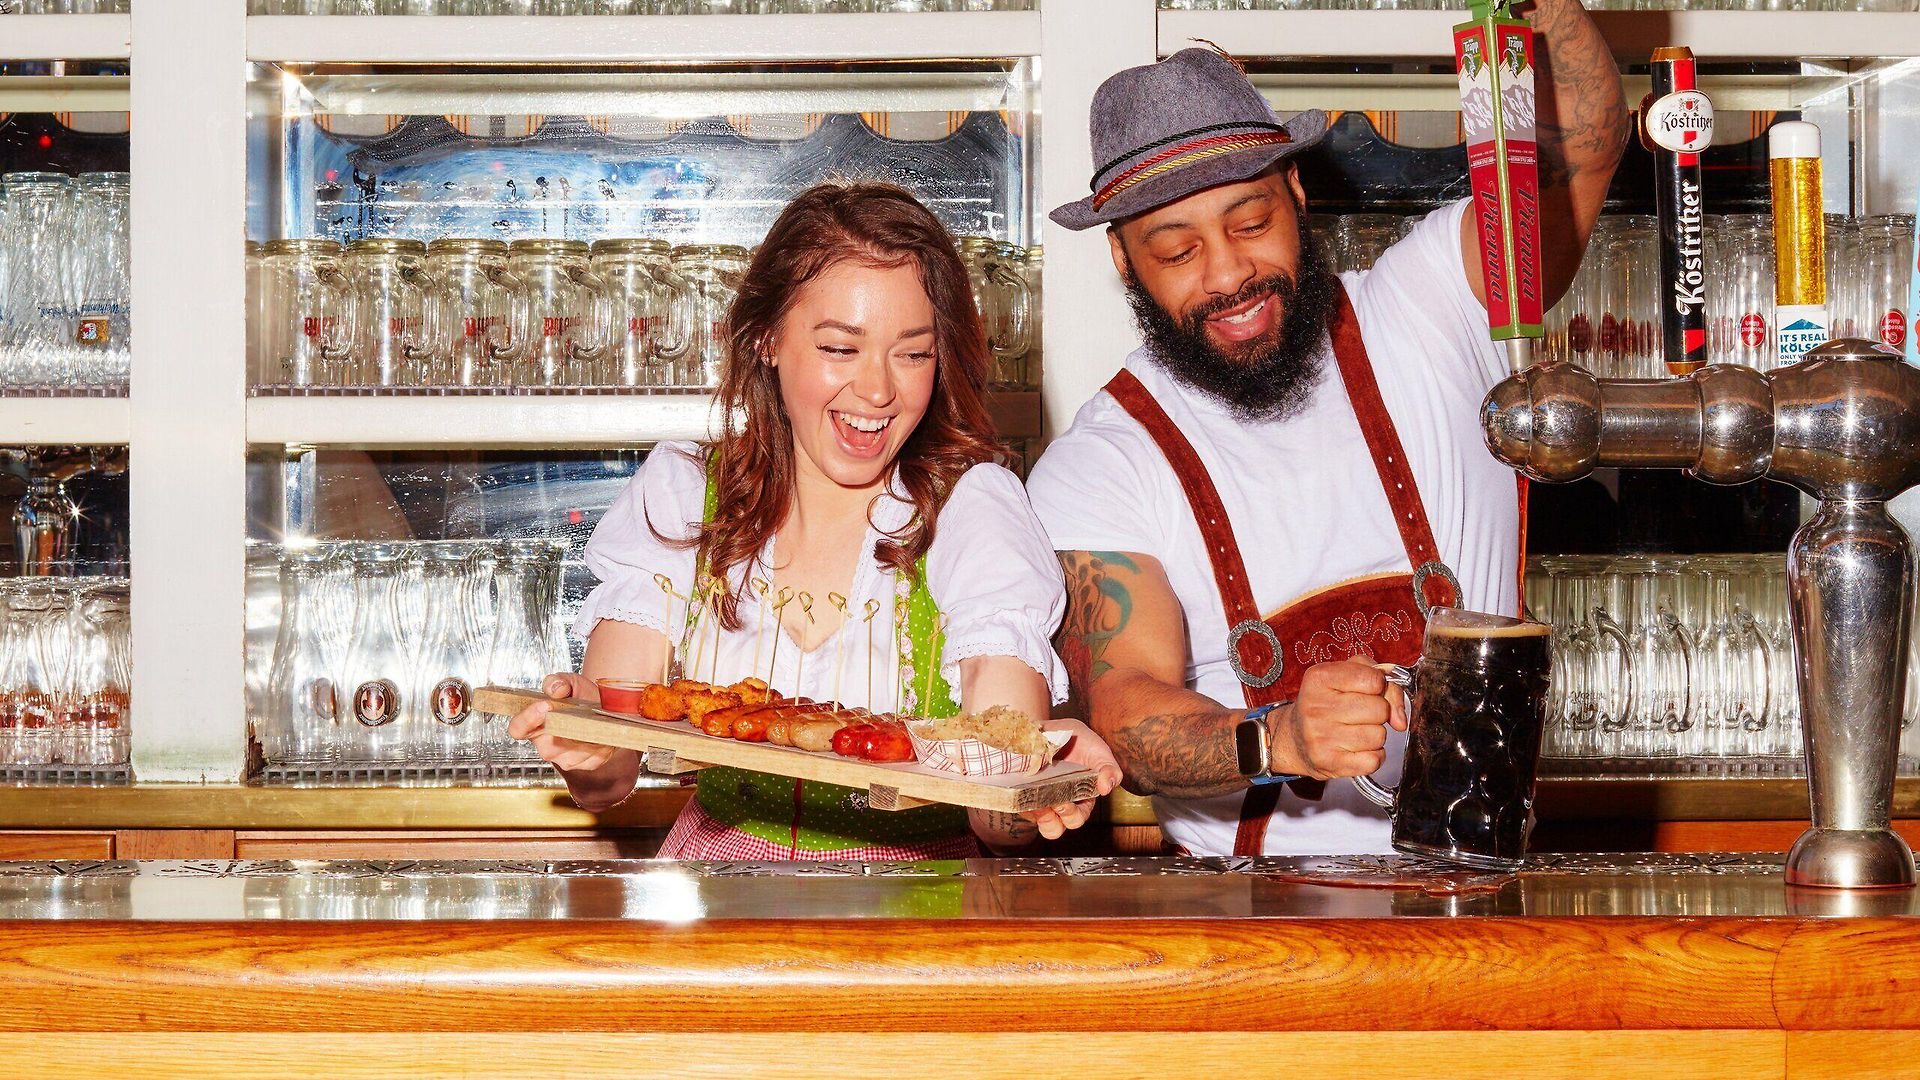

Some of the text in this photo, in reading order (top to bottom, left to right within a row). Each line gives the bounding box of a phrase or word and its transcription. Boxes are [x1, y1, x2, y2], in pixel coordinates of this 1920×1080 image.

[1480, 181, 1503, 302] Vienna
[1516, 181, 1536, 302] Vienna
[1674, 179, 1706, 315] Köstritzer
[1780, 333, 1827, 342] IT'S REAL
